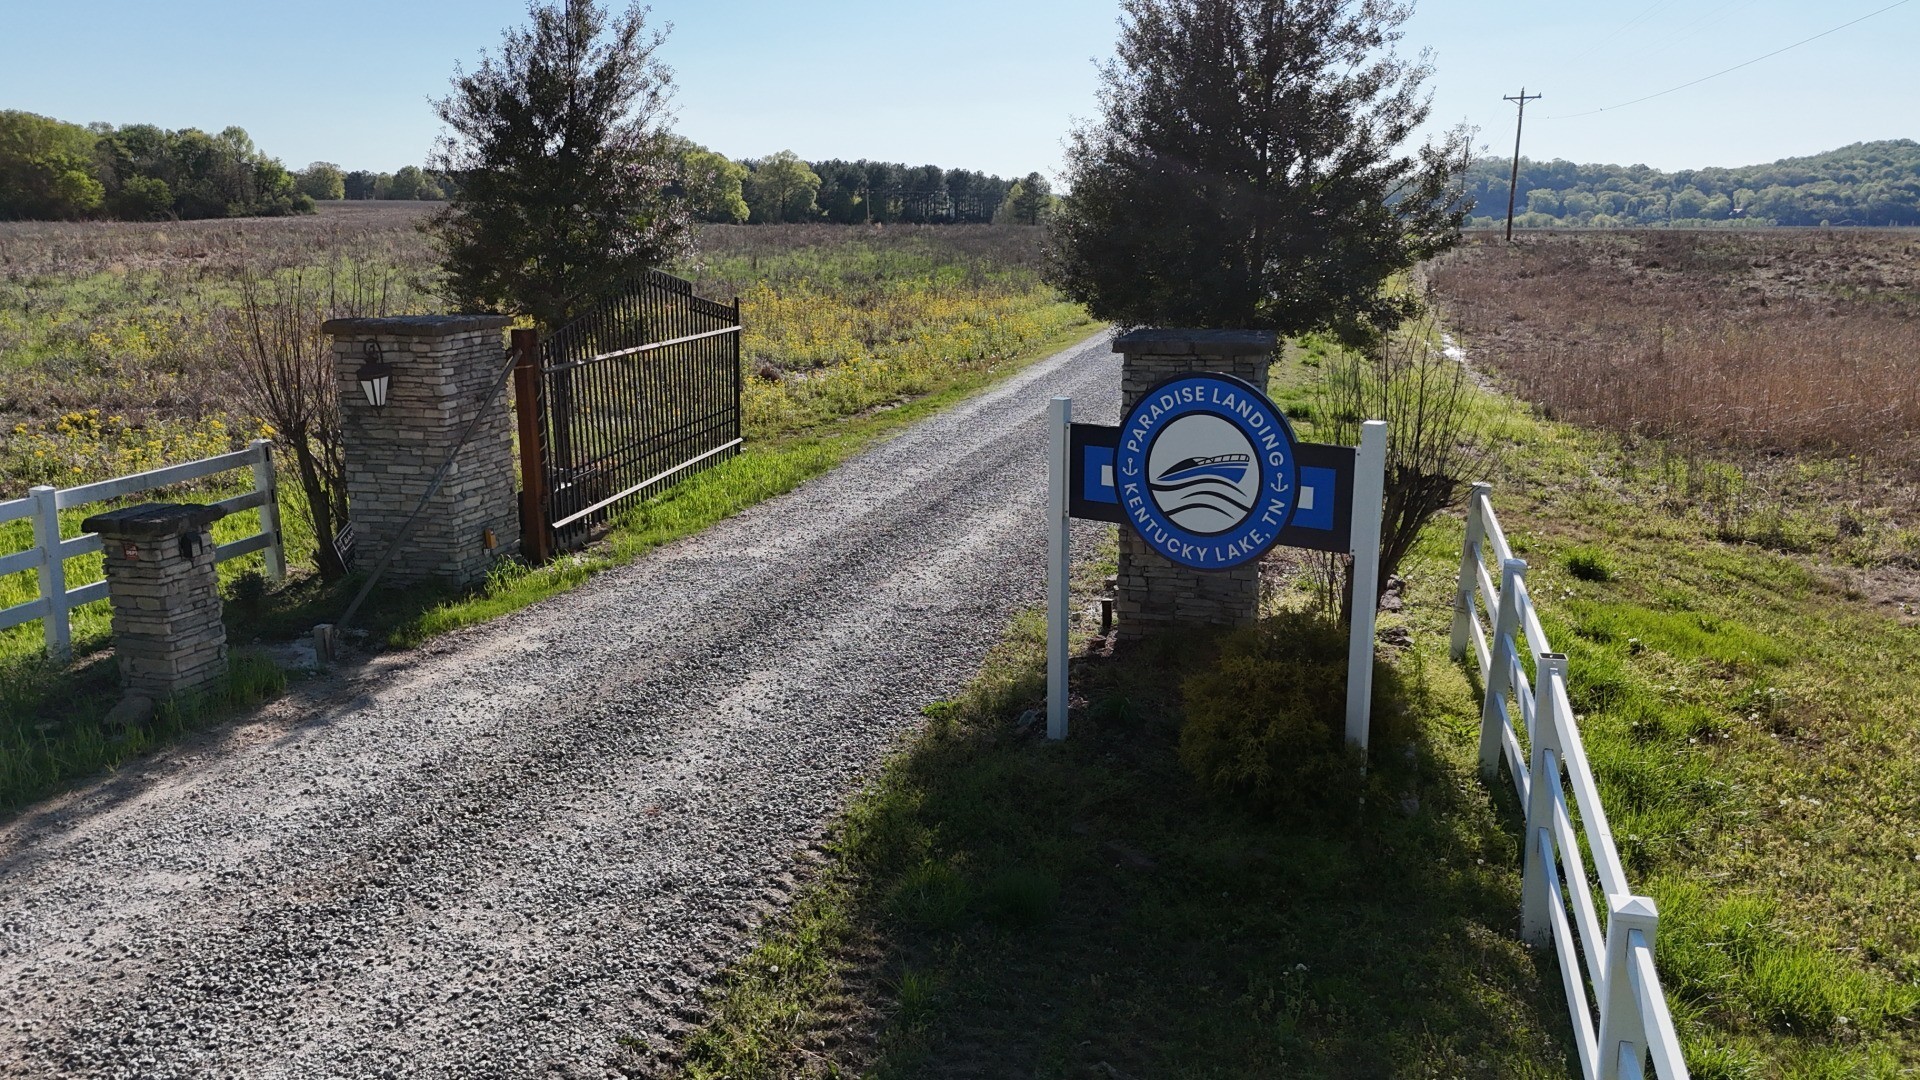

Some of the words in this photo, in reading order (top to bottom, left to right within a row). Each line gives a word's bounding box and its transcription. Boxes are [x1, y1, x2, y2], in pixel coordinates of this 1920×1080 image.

[1127, 386, 1205, 453] PARADISE
[1212, 388, 1284, 466] LANDING
[1124, 482, 1208, 562] KENTUCKY
[1215, 528, 1271, 562] LAKE,
[1262, 498, 1286, 527] TN
